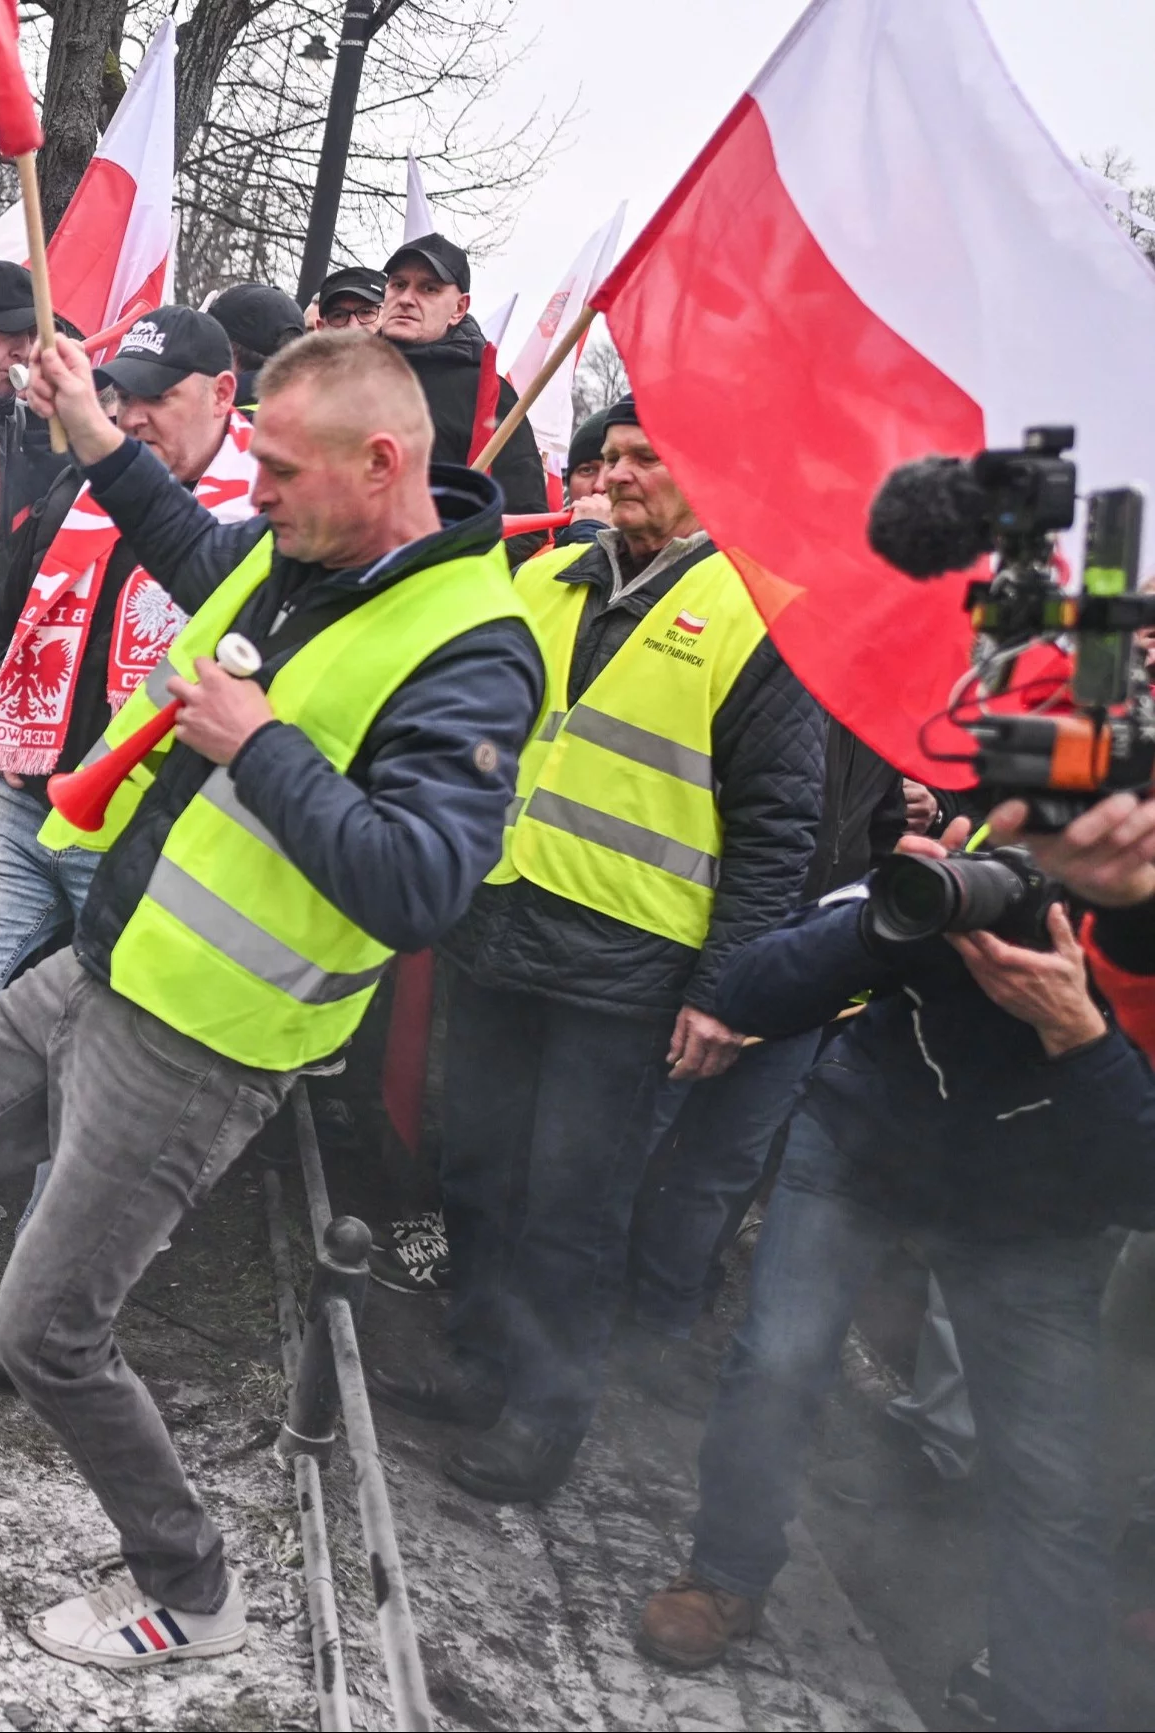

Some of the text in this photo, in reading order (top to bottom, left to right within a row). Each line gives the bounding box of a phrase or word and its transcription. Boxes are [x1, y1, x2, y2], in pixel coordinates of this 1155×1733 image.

[665, 629, 697, 648] ROLNICY
[643, 638, 705, 668] POWIAT PABIANICKI
